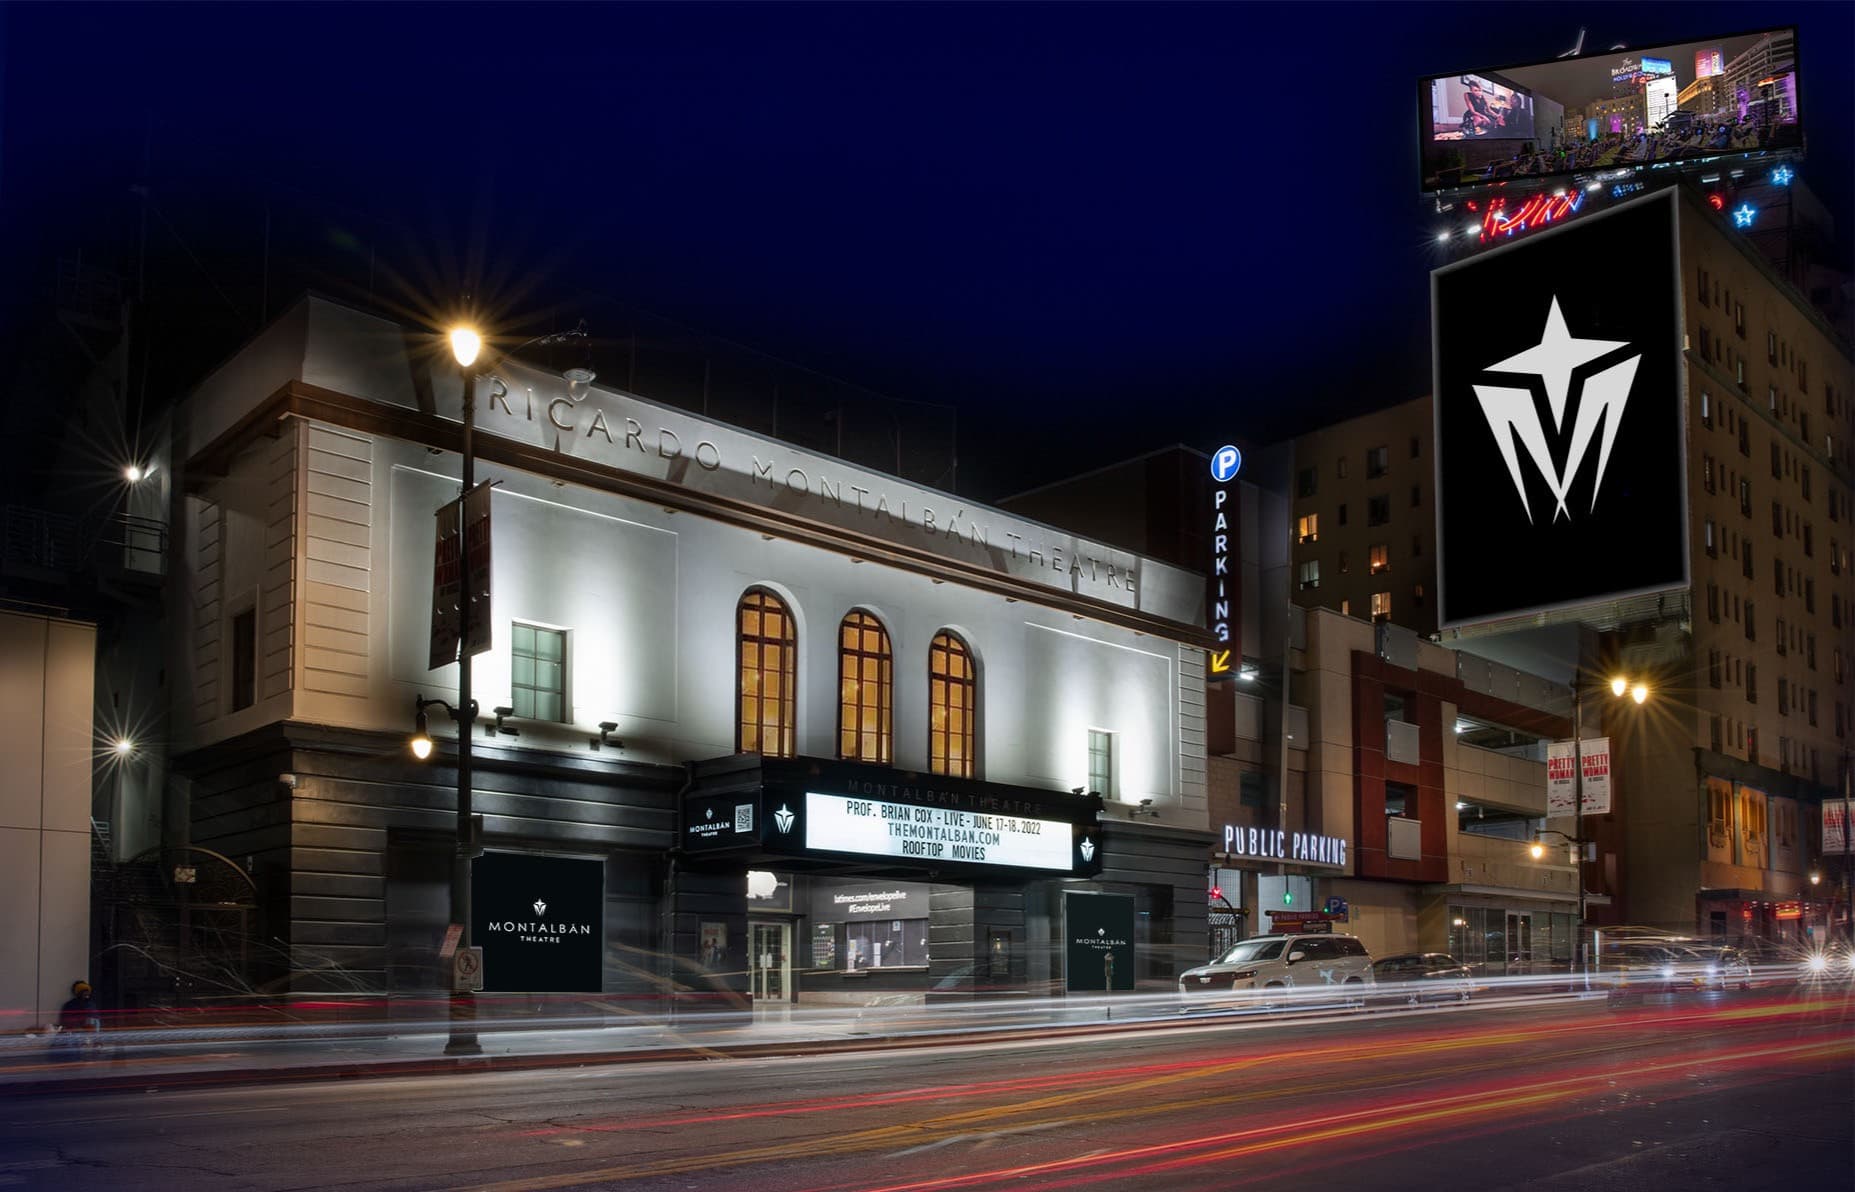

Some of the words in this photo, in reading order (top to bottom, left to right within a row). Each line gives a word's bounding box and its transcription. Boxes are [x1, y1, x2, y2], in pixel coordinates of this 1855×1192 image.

[1218, 450, 1236, 480] P
[489, 375, 721, 471] RICARDO
[751, 454, 989, 547] MONTALBÁN
[1006, 531, 1137, 593] THEATRE
[1214, 489, 1230, 643] PARKING
[1548, 757, 1575, 770] PRETTY
[1582, 754, 1608, 768] PRETTY
[1583, 766, 1608, 777] WOMAN
[1549, 769, 1575, 780] WOMAN
[968, 794, 1043, 816] THEATRE
[846, 800, 876, 817] PROF.
[881, 804, 911, 821] BRIAN
[914, 808, 933, 823] COX
[944, 811, 965, 827] LIVE
[973, 815, 993, 830] JUNE
[996, 818, 1041, 835] 17-18.2022
[888, 822, 1000, 846] THEMONTALBAN.COM
[1224, 824, 1286, 859] PUBLIC
[1292, 831, 1348, 866] PARKING
[902, 840, 944, 856] ROOFTOP
[952, 845, 986, 860] MOVIES
[520, 935, 561, 943] THEATRE
